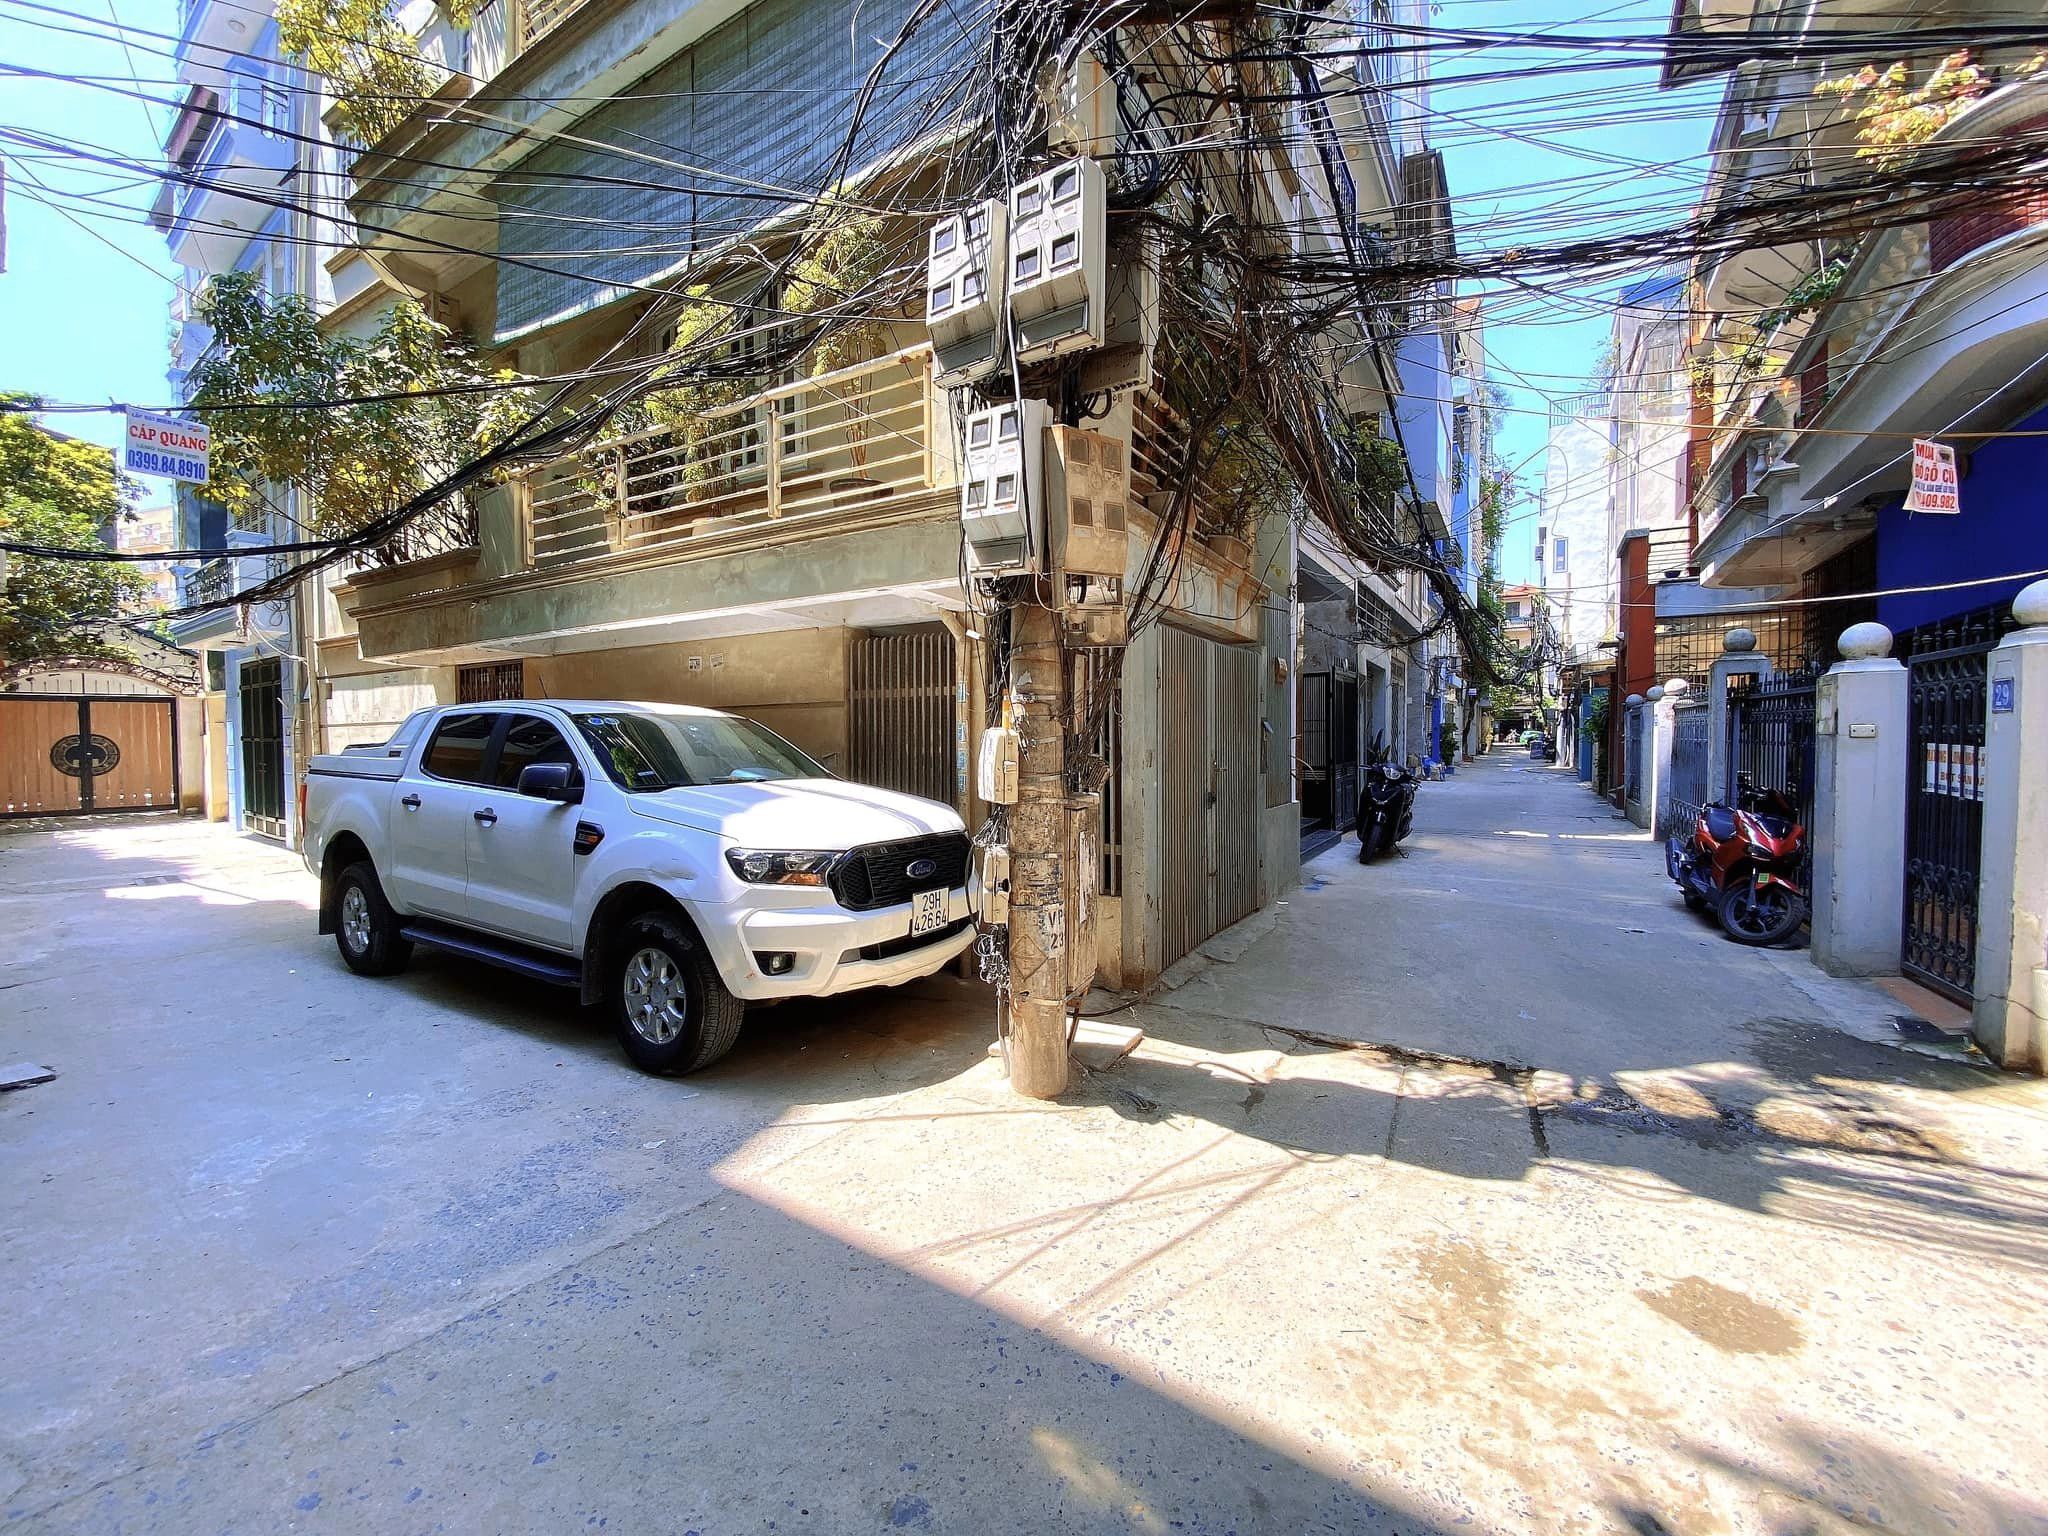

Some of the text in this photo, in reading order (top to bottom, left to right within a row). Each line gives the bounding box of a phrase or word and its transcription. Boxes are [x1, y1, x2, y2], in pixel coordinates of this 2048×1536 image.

[129, 424, 156, 440] CÁP
[160, 431, 207, 452] QUANG
[1915, 443, 1934, 460] MUA
[128, 449, 206, 481] 0399.84.8910
[1995, 683, 2009, 707] 29
[922, 890, 941, 912] 29H
[914, 908, 947, 933] 426.64
